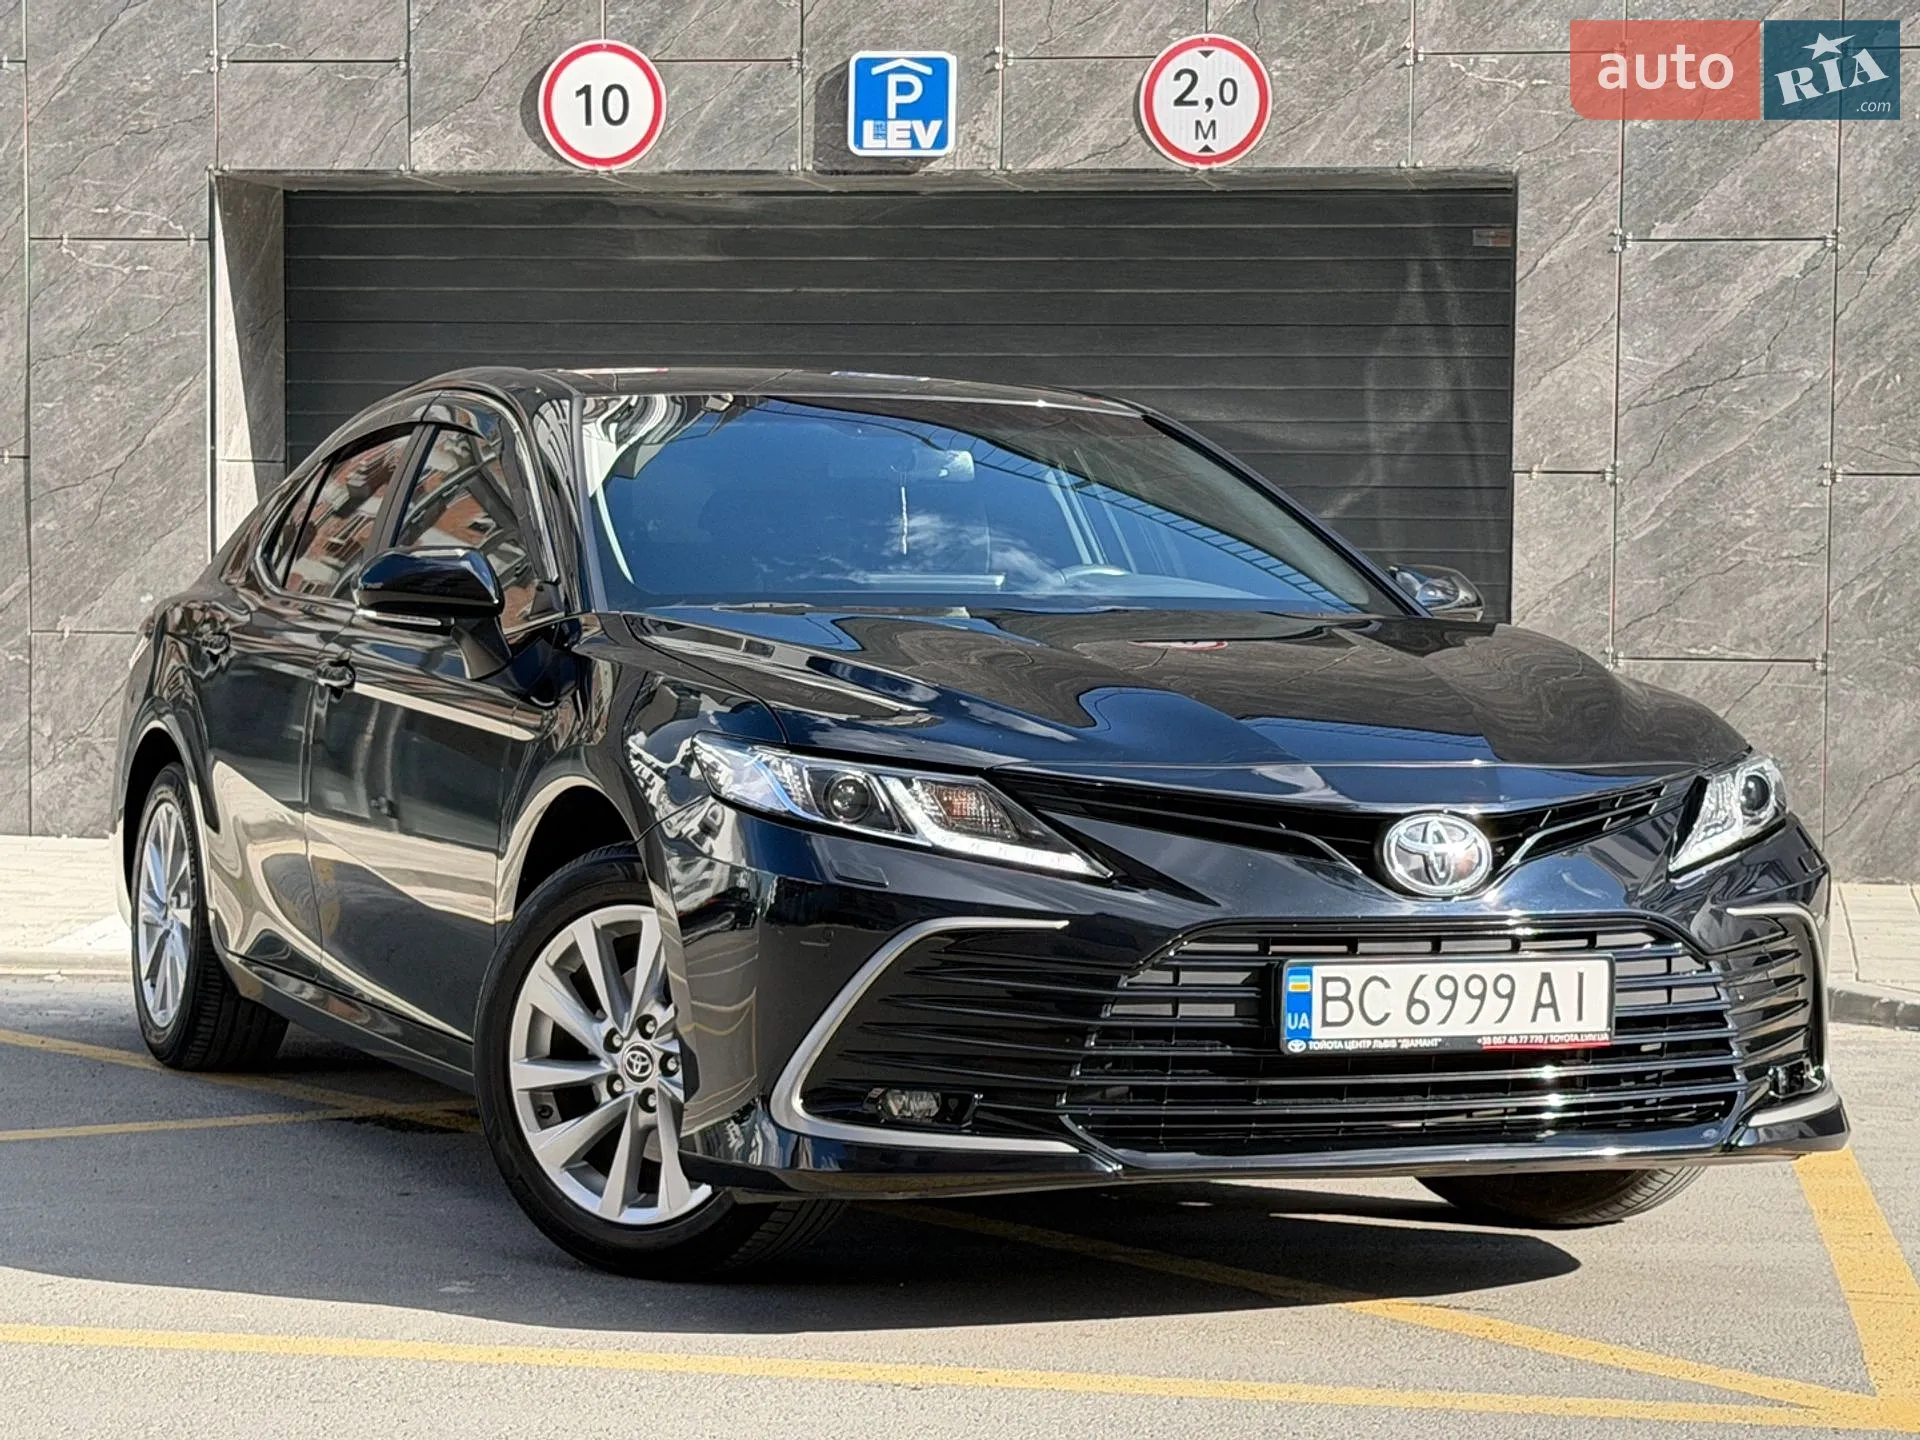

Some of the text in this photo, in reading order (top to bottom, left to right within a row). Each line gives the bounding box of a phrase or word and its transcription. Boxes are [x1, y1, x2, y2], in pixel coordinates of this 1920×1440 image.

[575, 83, 630, 127] 10
[886, 73, 924, 119] P
[1173, 69, 1239, 112] 2,0
[862, 119, 943, 149] LEV
[1320, 970, 1585, 1029] BC 6999 AI
[1287, 1013, 1310, 1030] UA
